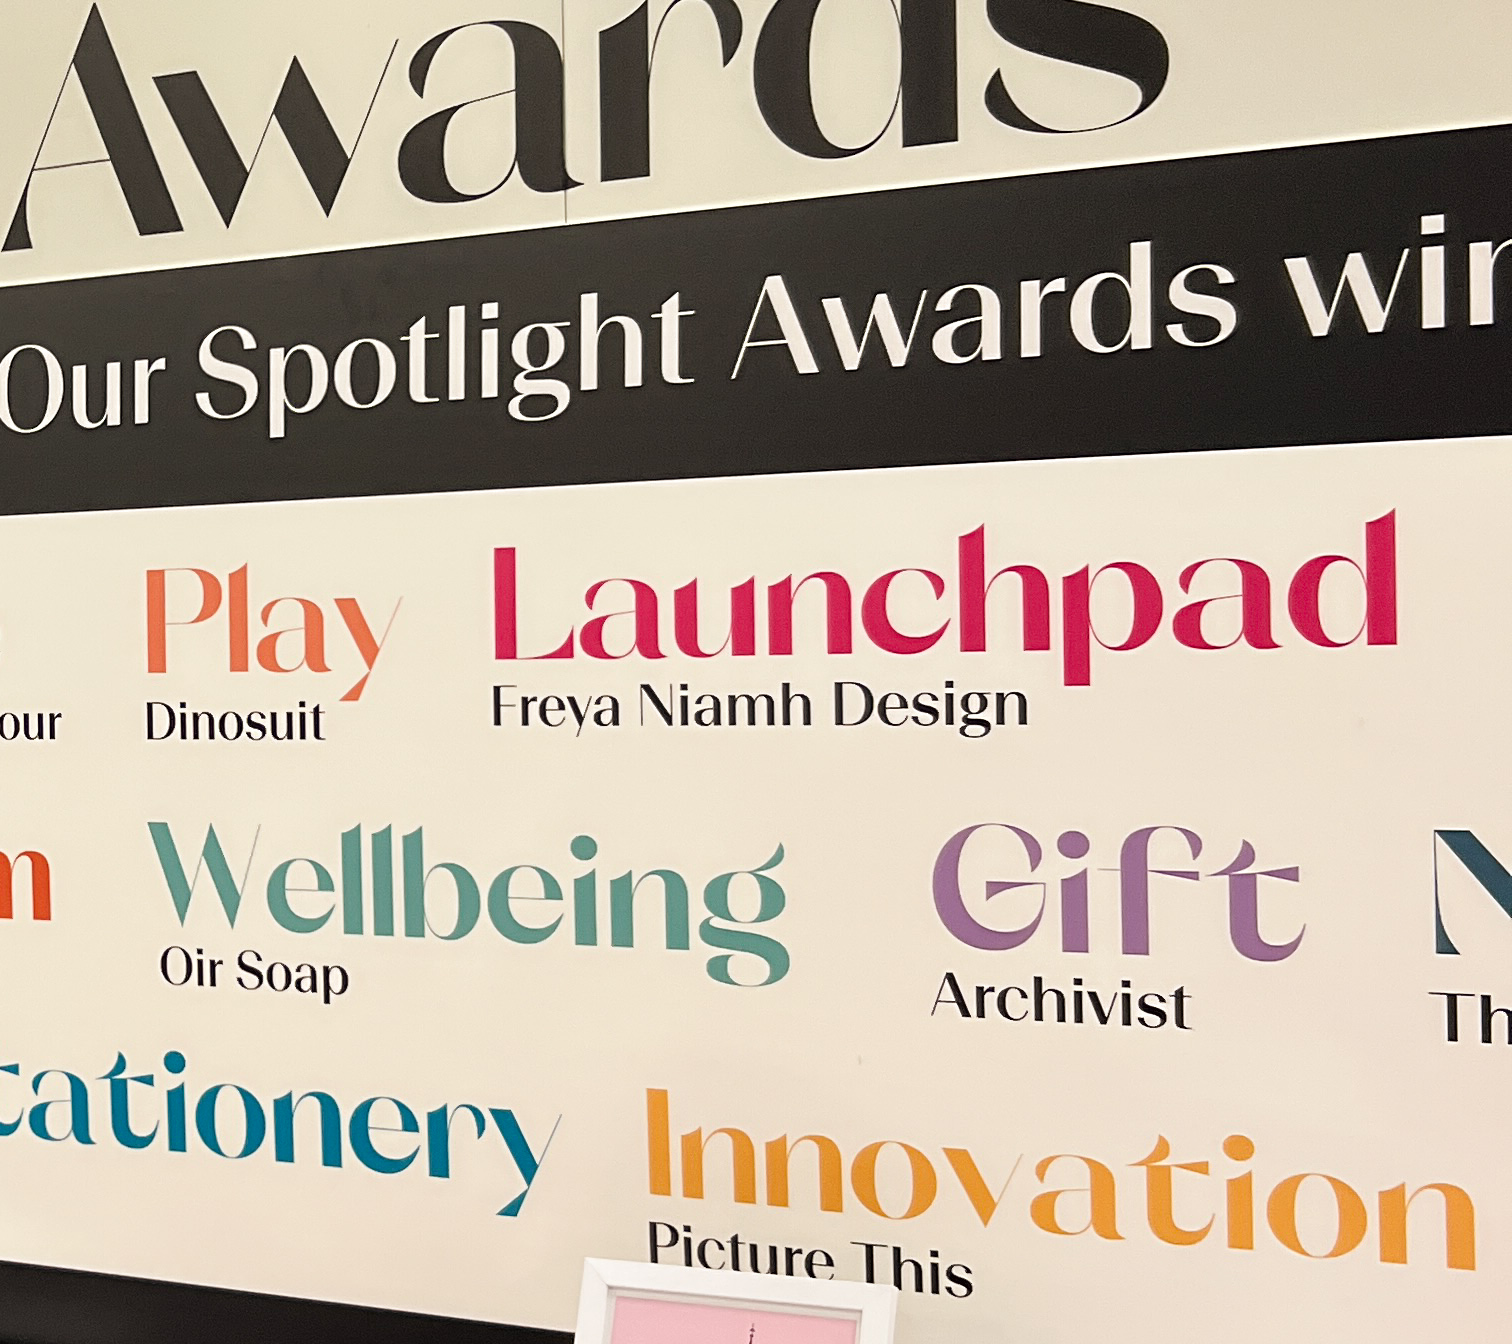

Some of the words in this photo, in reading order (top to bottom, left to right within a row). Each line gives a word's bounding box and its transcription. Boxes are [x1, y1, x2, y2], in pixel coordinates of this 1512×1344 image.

[195, 291, 695, 439] Spotlight
[730, 240, 1239, 380] Awards
[146, 562, 403, 702] Play
[493, 508, 1398, 687] Launchpad
[145, 700, 327, 741] Dinosuit
[491, 684, 621, 737] Freya
[639, 682, 812, 728] Niamh
[833, 680, 1029, 739] Design
[147, 822, 790, 987] Wellbeing
[932, 823, 1306, 962] Gift
[160, 946, 224, 987] Oir
[236, 950, 349, 1005] Soap
[931, 972, 1193, 1029] Archivist
[645, 1087, 1477, 1271] Innovation
[649, 1221, 835, 1281] Picture
[850, 1242, 973, 1298] This
